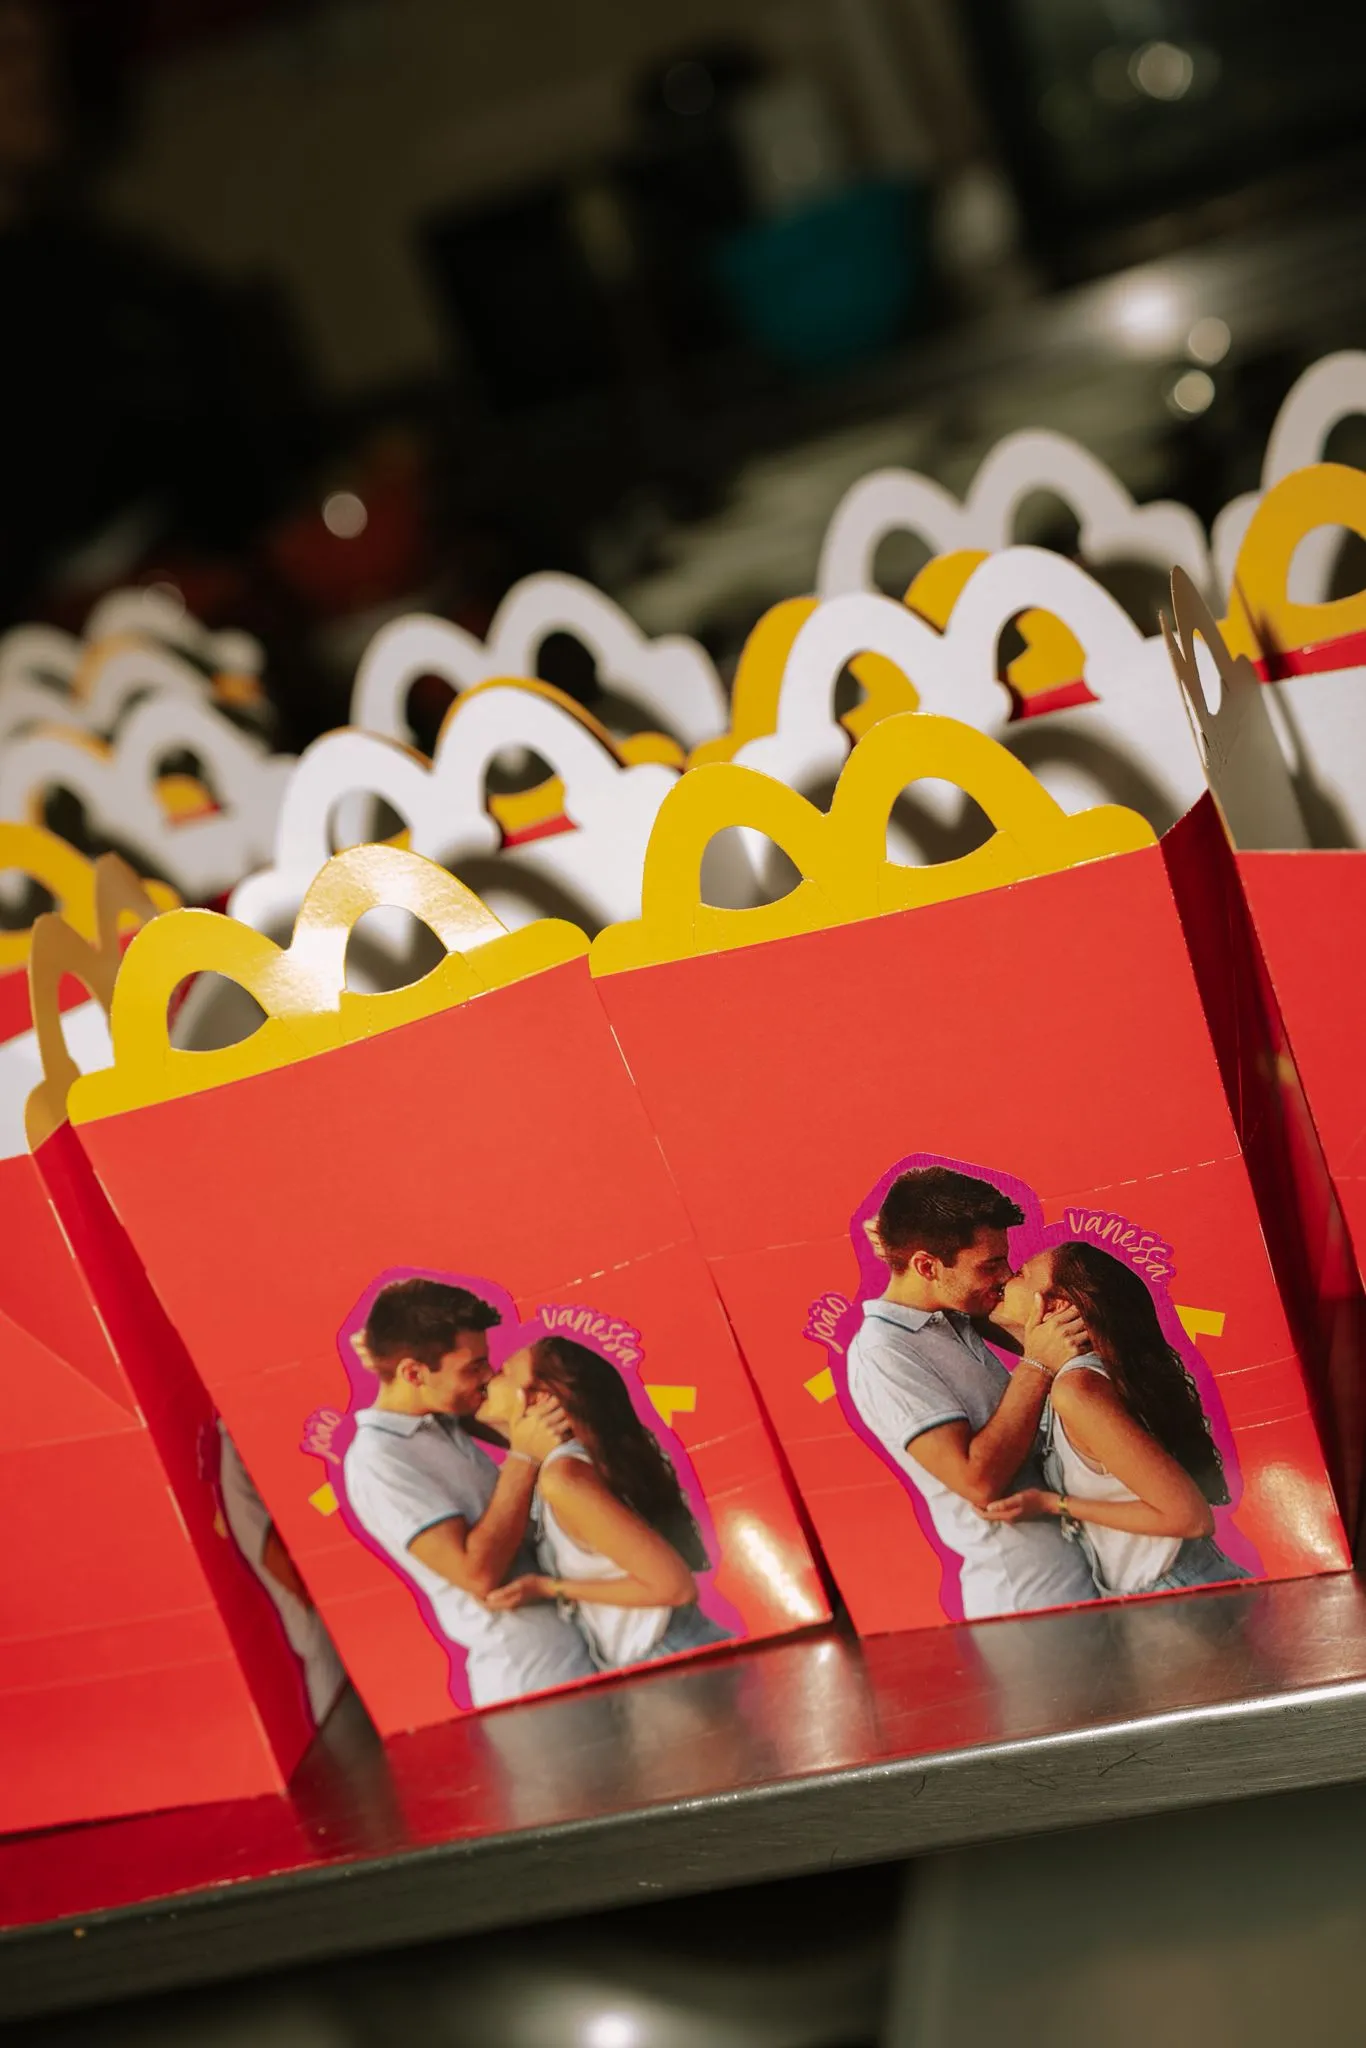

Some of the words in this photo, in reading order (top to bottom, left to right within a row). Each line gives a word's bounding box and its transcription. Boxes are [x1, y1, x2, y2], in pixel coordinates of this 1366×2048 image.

[1068, 1212, 1170, 1283] vanessa
[541, 1307, 639, 1368] vanessa
[807, 1296, 848, 1355] joão
